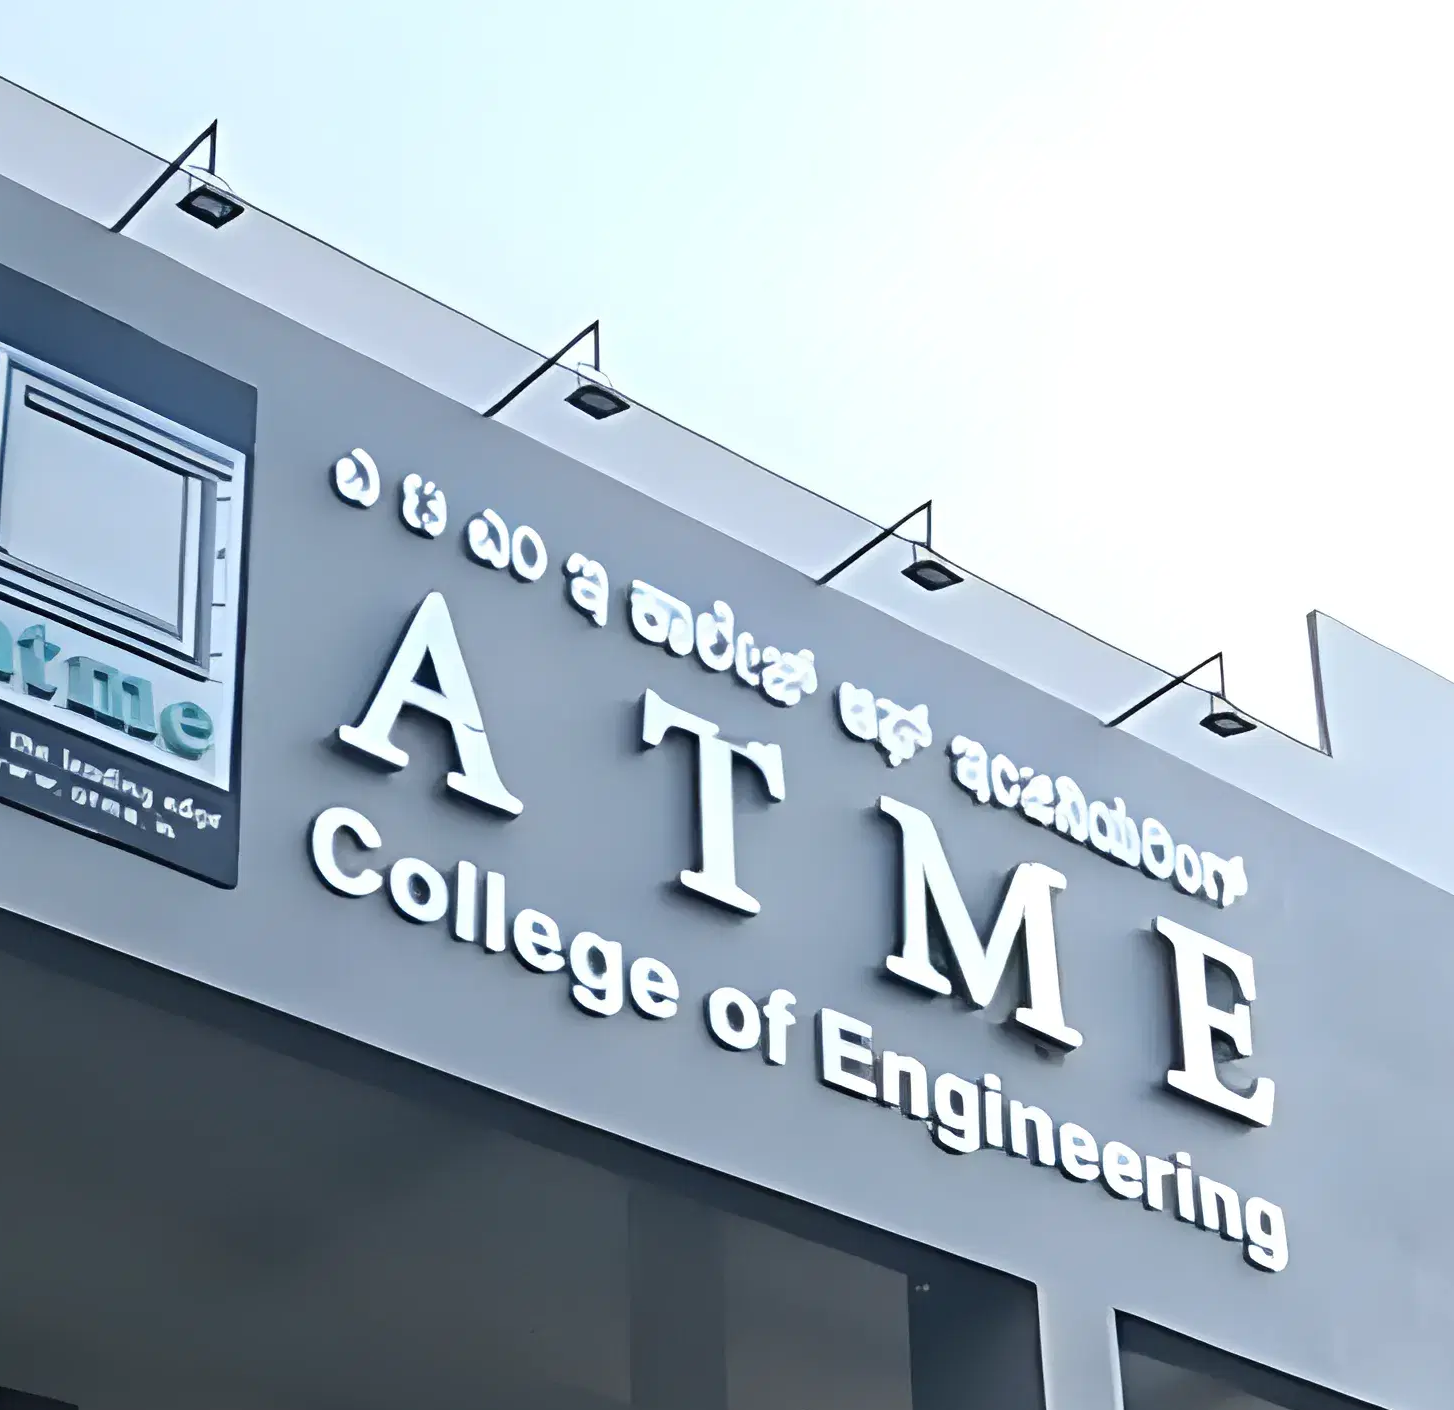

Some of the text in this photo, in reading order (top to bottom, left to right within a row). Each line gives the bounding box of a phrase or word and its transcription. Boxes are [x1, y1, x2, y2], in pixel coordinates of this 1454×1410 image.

[310, 806, 1289, 1272] College of Engineering
